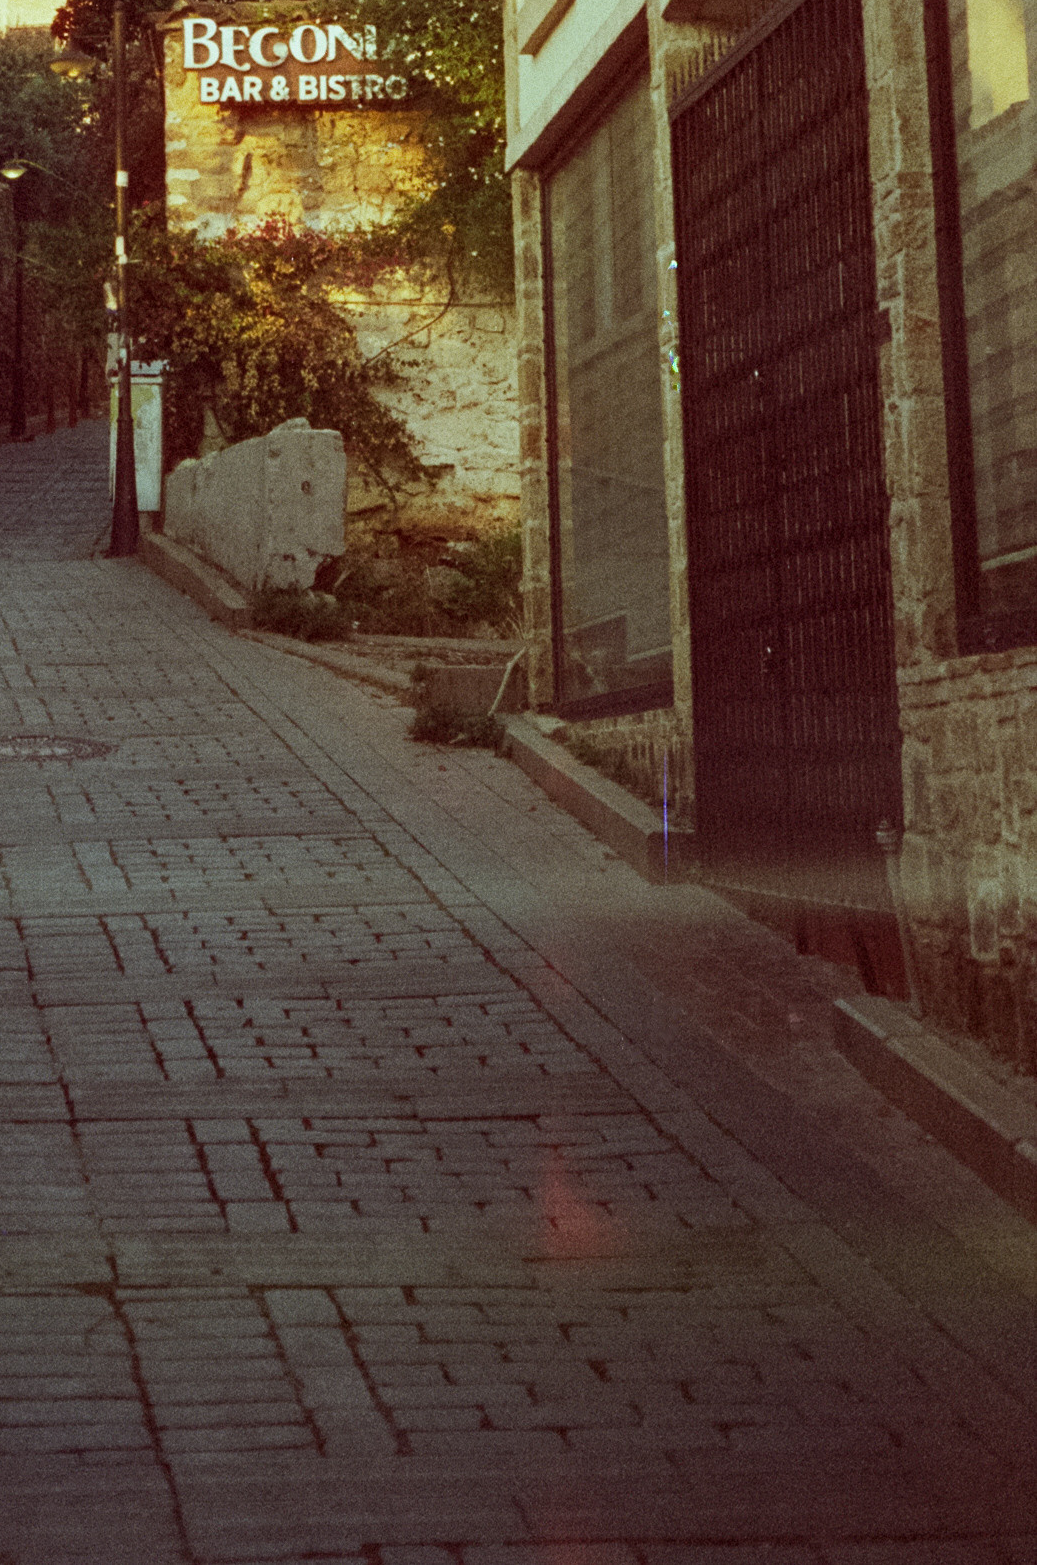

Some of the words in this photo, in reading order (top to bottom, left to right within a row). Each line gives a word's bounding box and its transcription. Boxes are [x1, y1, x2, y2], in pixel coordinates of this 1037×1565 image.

[200, 76, 262, 103] BAR
[269, 75, 290, 102] &
[298, 74, 408, 101] BISTRO
